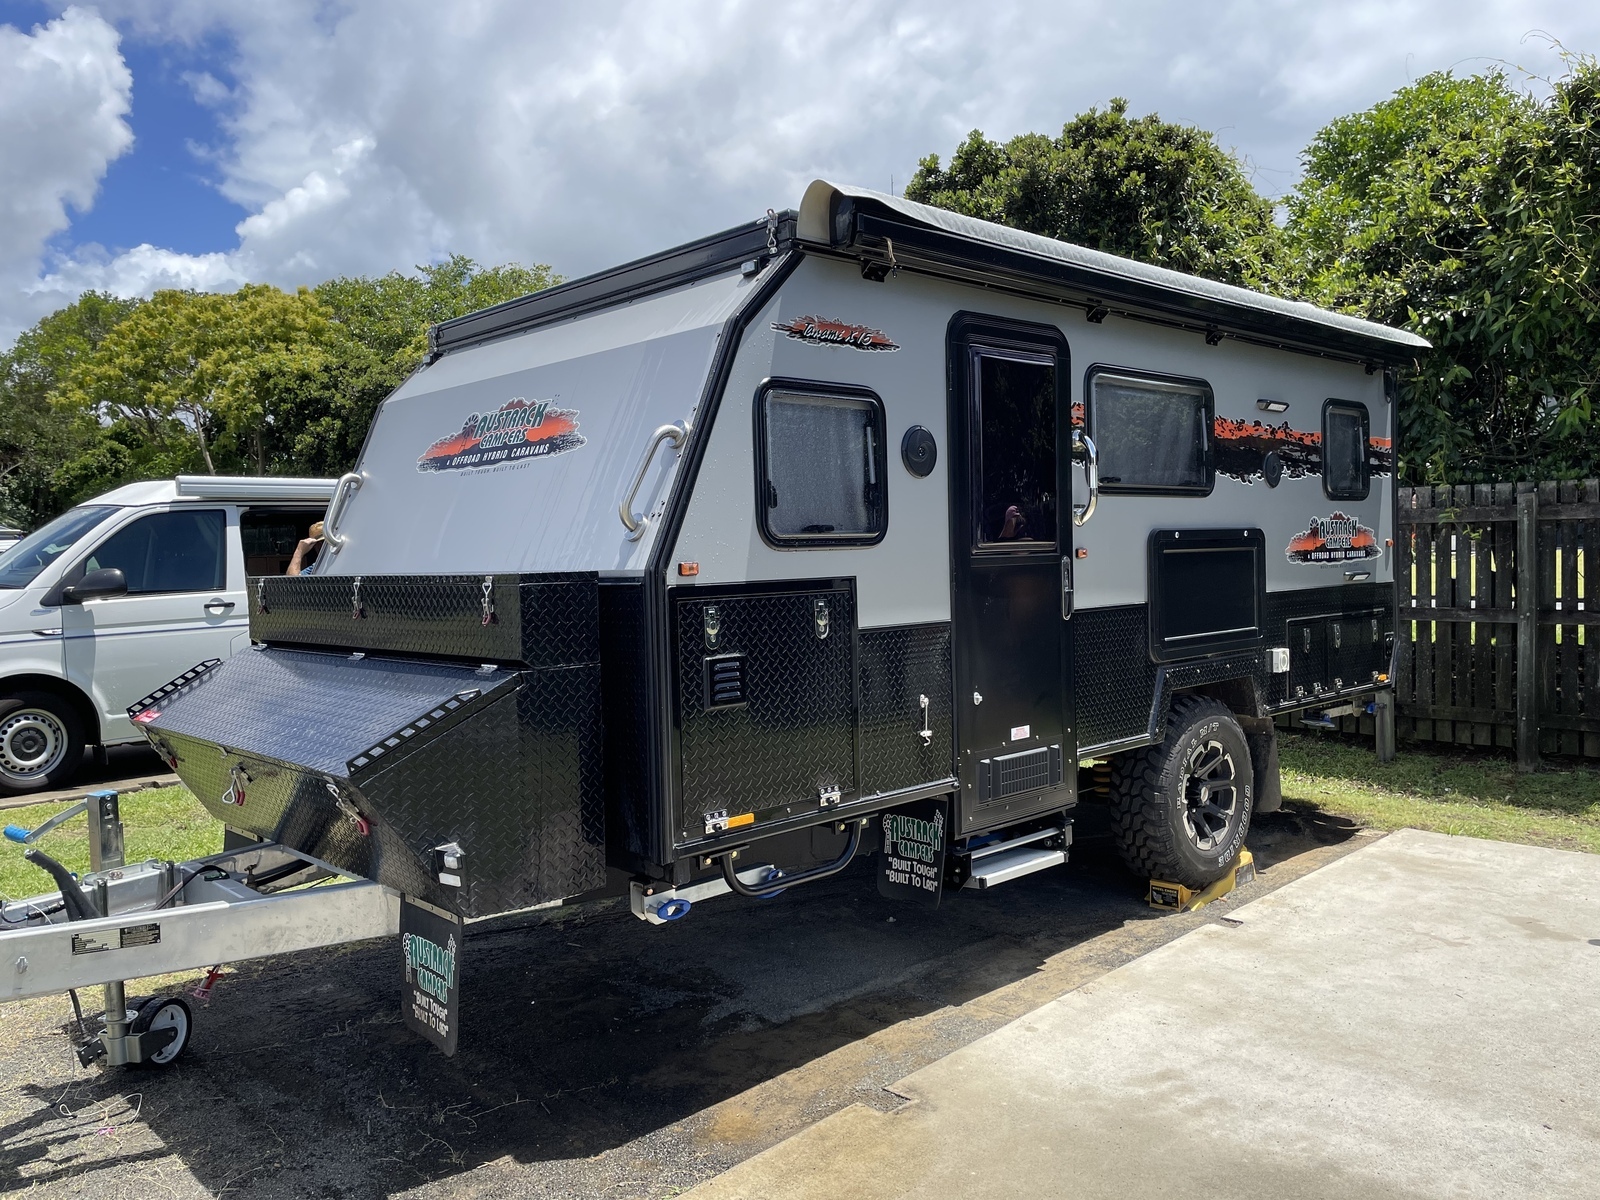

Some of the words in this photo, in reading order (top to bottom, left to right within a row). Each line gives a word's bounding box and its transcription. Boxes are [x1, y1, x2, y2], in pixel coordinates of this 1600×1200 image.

[803, 322, 845, 341] Tanami
[473, 402, 549, 438] AUSTRACK
[480, 428, 529, 449] CAMPERS
[452, 453, 481, 466] OFFROAD
[482, 450, 508, 462] HYBRID
[511, 443, 550, 457] CARAVANS
[1320, 519, 1358, 539] AUSTRACK
[1325, 536, 1352, 548] CAMPERS
[1311, 551, 1330, 560] OFFROAD
[1330, 551, 1345, 559] HYBRID
[890, 814, 941, 851] AUSTRACK
[898, 840, 934, 863] CAMPERS
[911, 874, 921, 887] TO
[410, 934, 454, 989] AUSTRACK
[417, 967, 448, 1004] CAMPERS
[429, 1014, 436, 1029] TO
